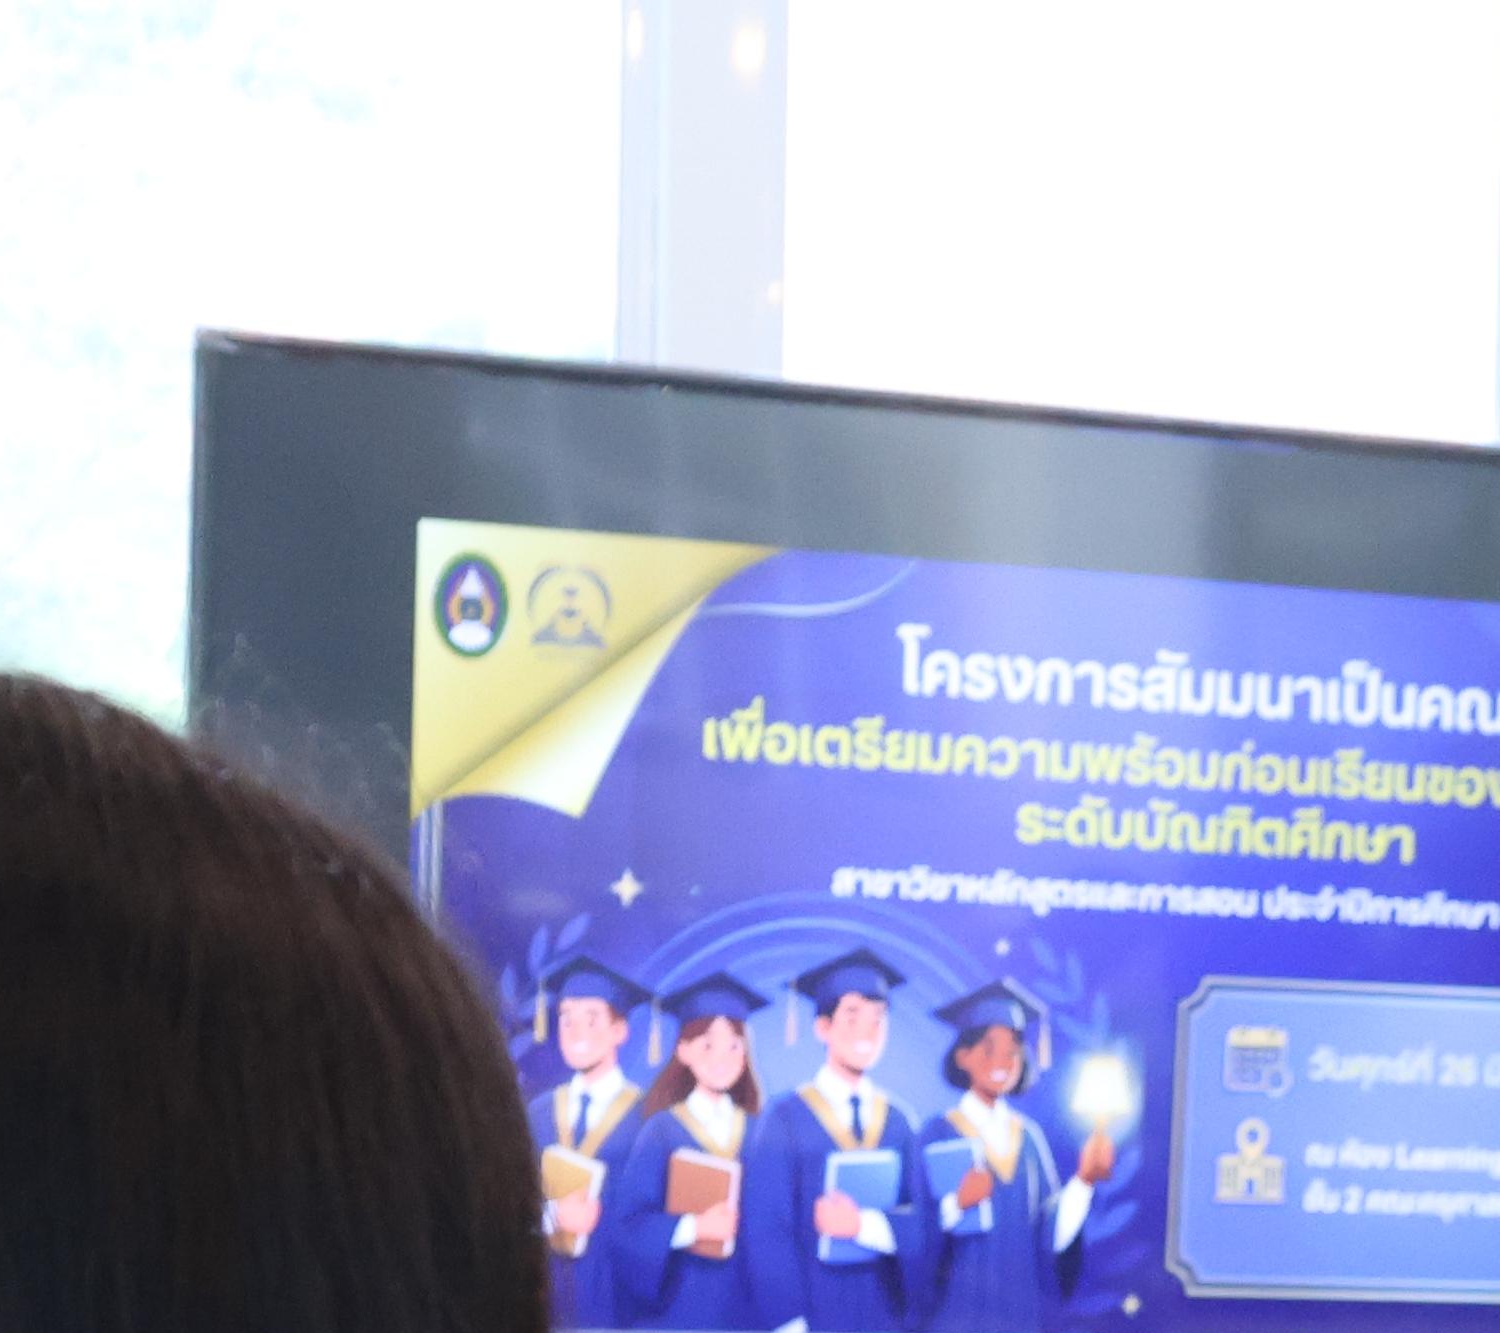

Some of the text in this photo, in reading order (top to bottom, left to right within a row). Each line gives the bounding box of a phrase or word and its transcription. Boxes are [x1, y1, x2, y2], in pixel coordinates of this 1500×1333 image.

[1015, 793, 1416, 865] ระดับบัณฑิตศึกษา
[831, 864, 1259, 918] สาขาวิชาหลักสูตรและการสอน
[1263, 884, 1500, 931] ประจำปีการศึกษา
